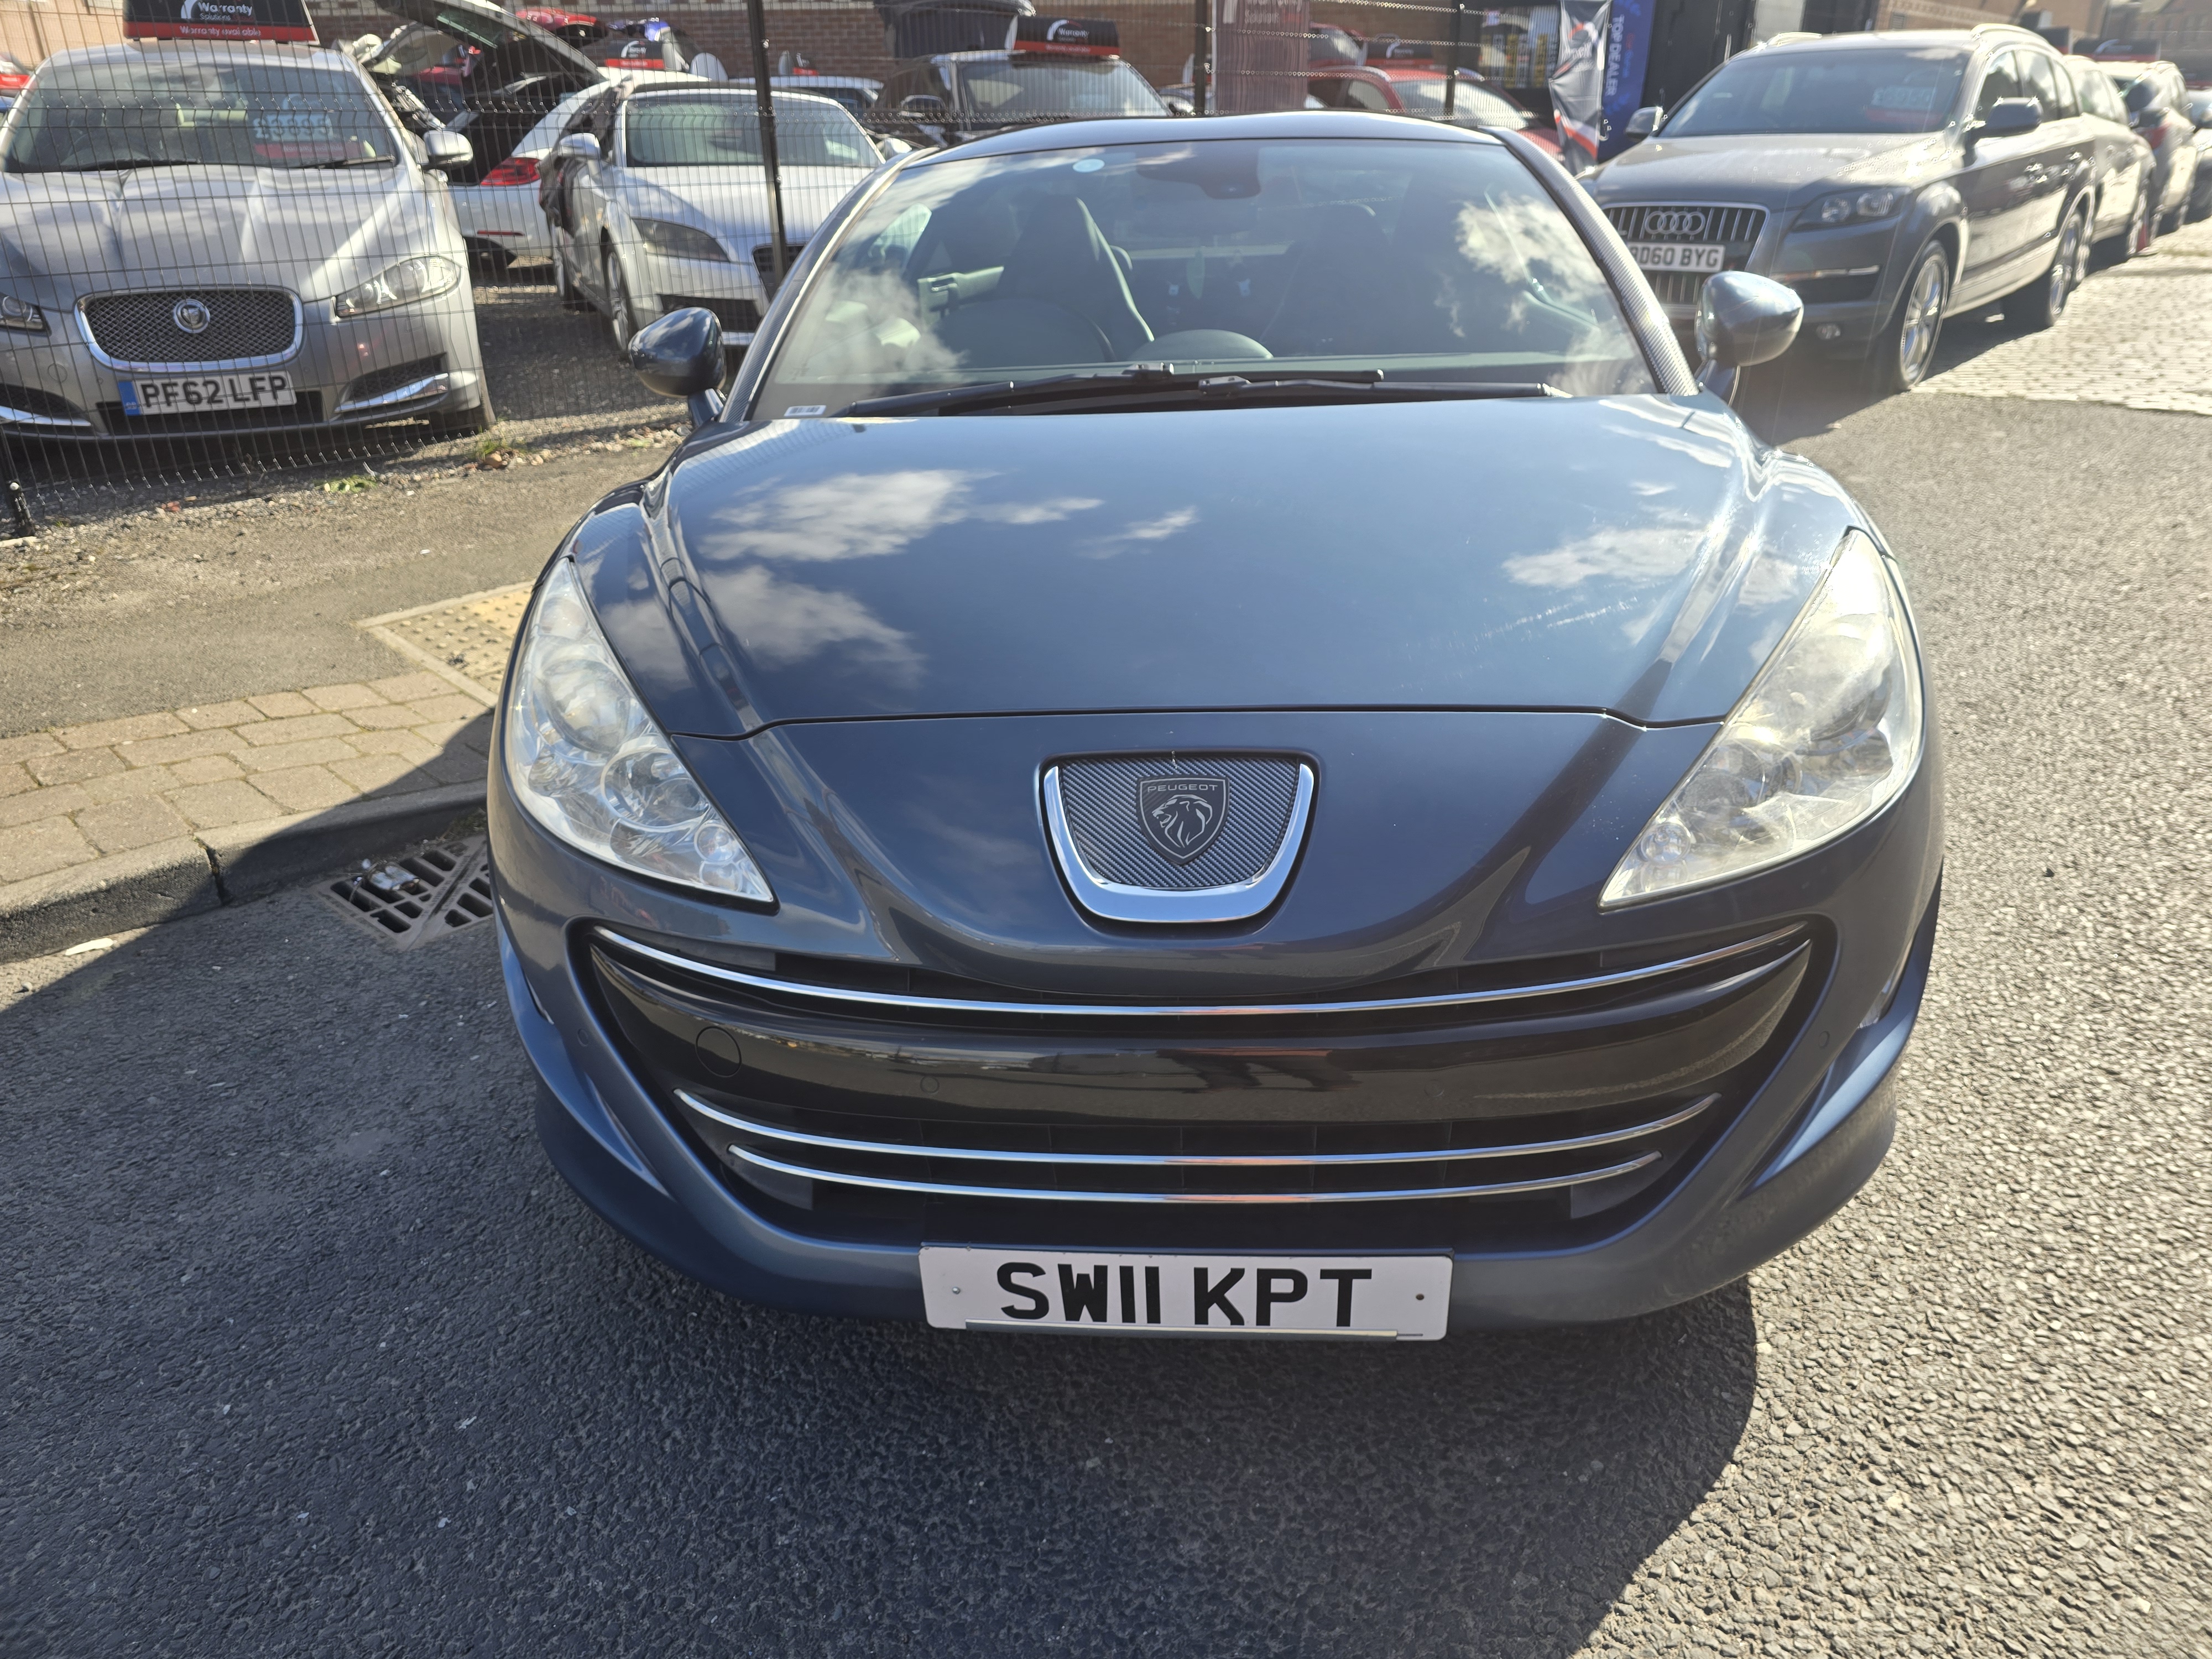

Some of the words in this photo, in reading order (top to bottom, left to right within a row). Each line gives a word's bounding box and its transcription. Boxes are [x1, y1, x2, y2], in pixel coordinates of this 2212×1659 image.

[198, 2, 252, 16] Warranty
[179, 25, 220, 36] Warranty
[221, 27, 261, 36] avaiable
[1611, 14, 1625, 42] TOP
[1605, 43, 1621, 96] DEALER
[1680, 248, 1719, 268] BYG
[140, 380, 224, 408] PF62
[228, 375, 287, 403] LFP
[1147, 784, 1218, 792] PEUGEOT
[1194, 1266, 1373, 1327] KPT
